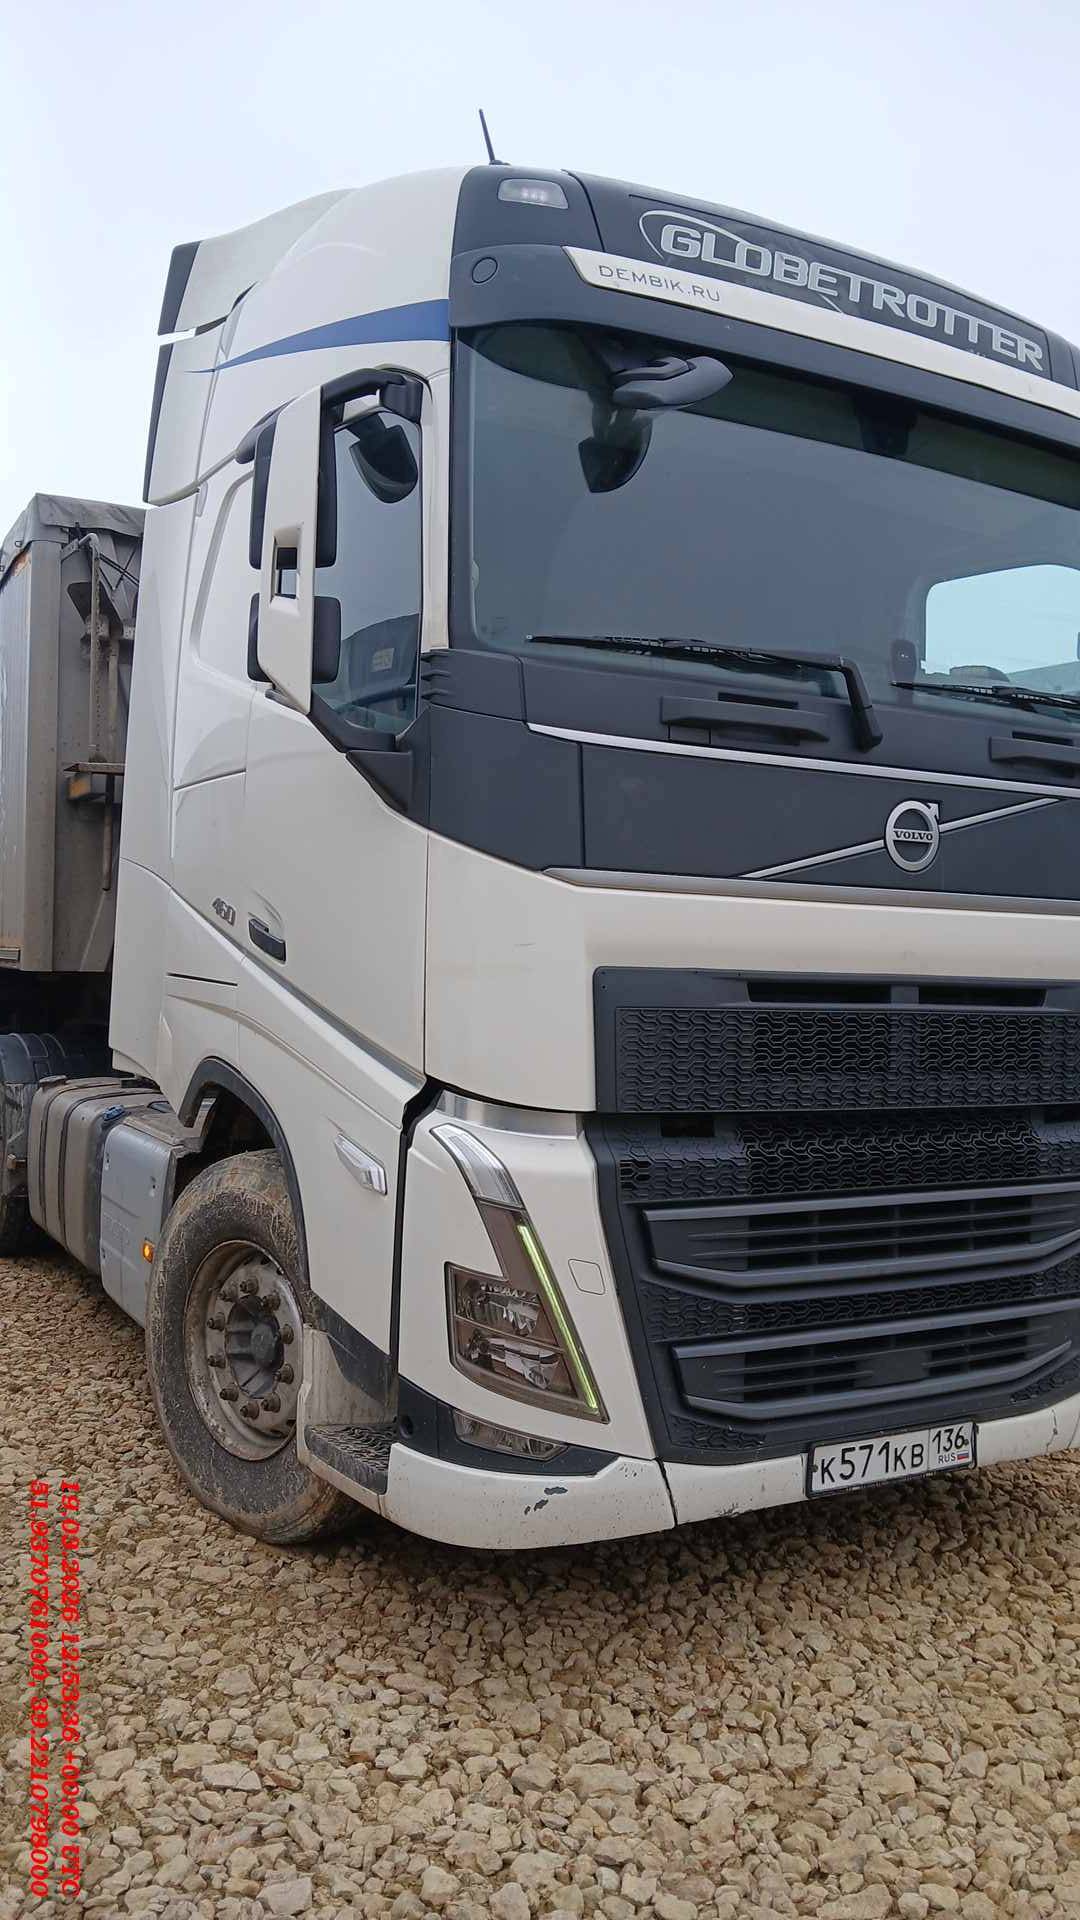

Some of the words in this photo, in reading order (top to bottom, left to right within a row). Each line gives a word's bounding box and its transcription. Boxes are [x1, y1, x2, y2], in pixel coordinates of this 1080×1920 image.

[598, 264, 721, 302] DEMBIK.RU
[660, 223, 1044, 371] GLOBETROTTER
[894, 829, 934, 841] VOLVO
[212, 897, 236, 927] 460
[932, 1426, 966, 1455] 136
[937, 1452, 957, 1464] RUS
